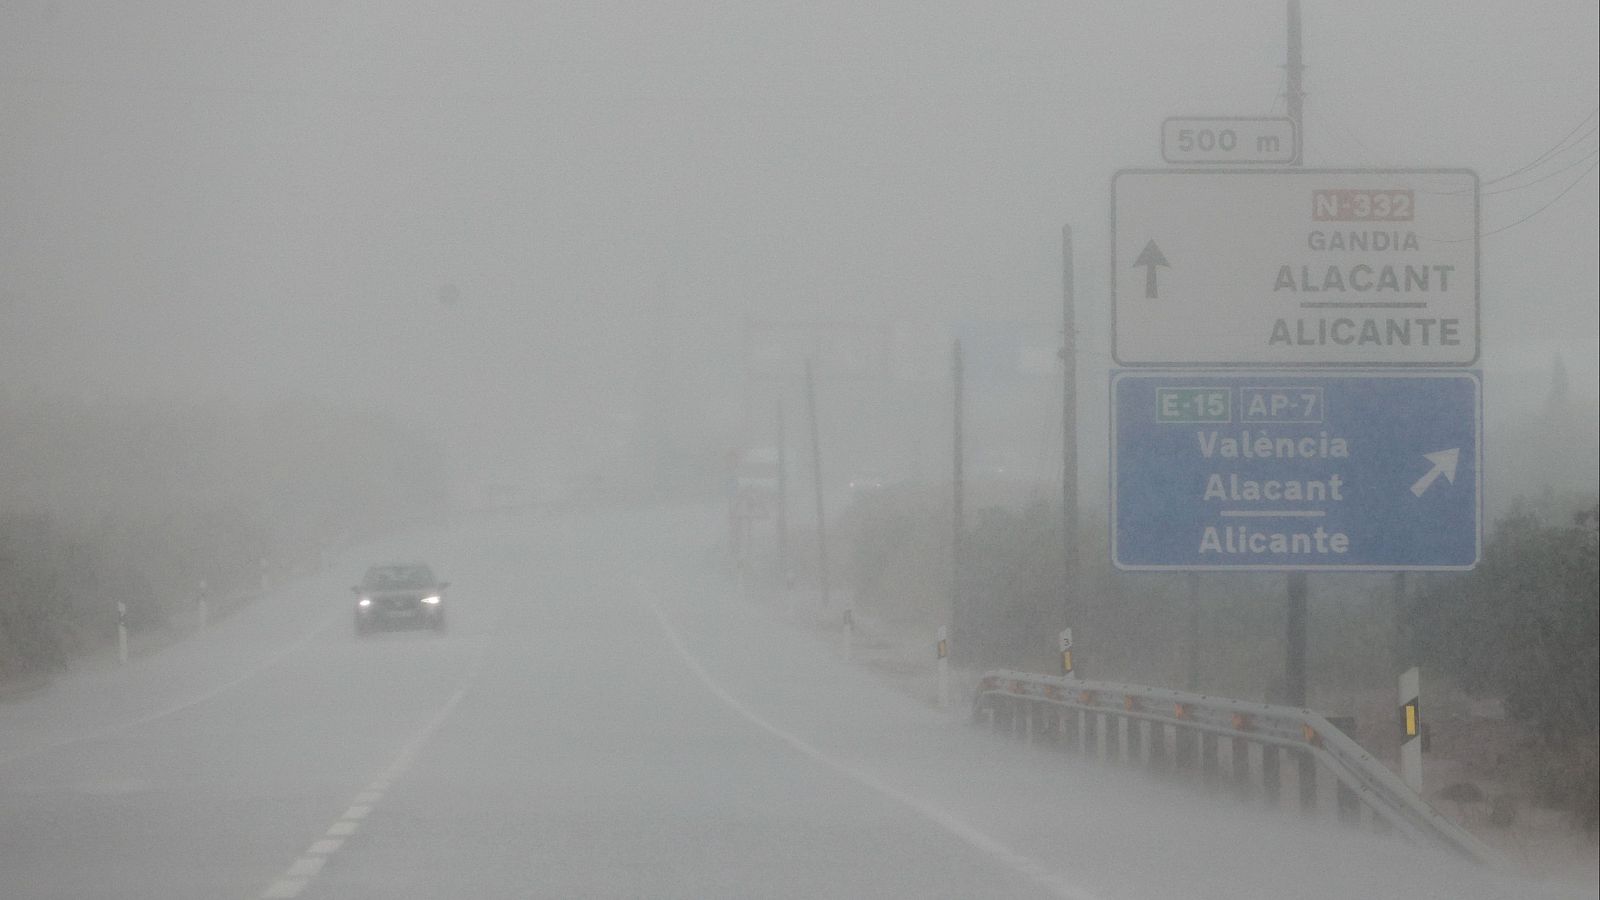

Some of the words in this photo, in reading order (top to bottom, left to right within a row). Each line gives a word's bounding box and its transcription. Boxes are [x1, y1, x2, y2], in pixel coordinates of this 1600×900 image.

[1177, 128, 1238, 152] 500
[1256, 131, 1281, 152] m
[1316, 194, 1412, 218] N-332
[1307, 230, 1420, 252] GANDIA
[1273, 263, 1456, 293] ALACANT
[1268, 317, 1462, 347] ALICANTE
[1161, 393, 1226, 418] E-15
[1248, 393, 1317, 418] AP-7
[1197, 430, 1350, 459] València
[1203, 472, 1344, 501] Alacant
[1199, 525, 1350, 554] Alicante
